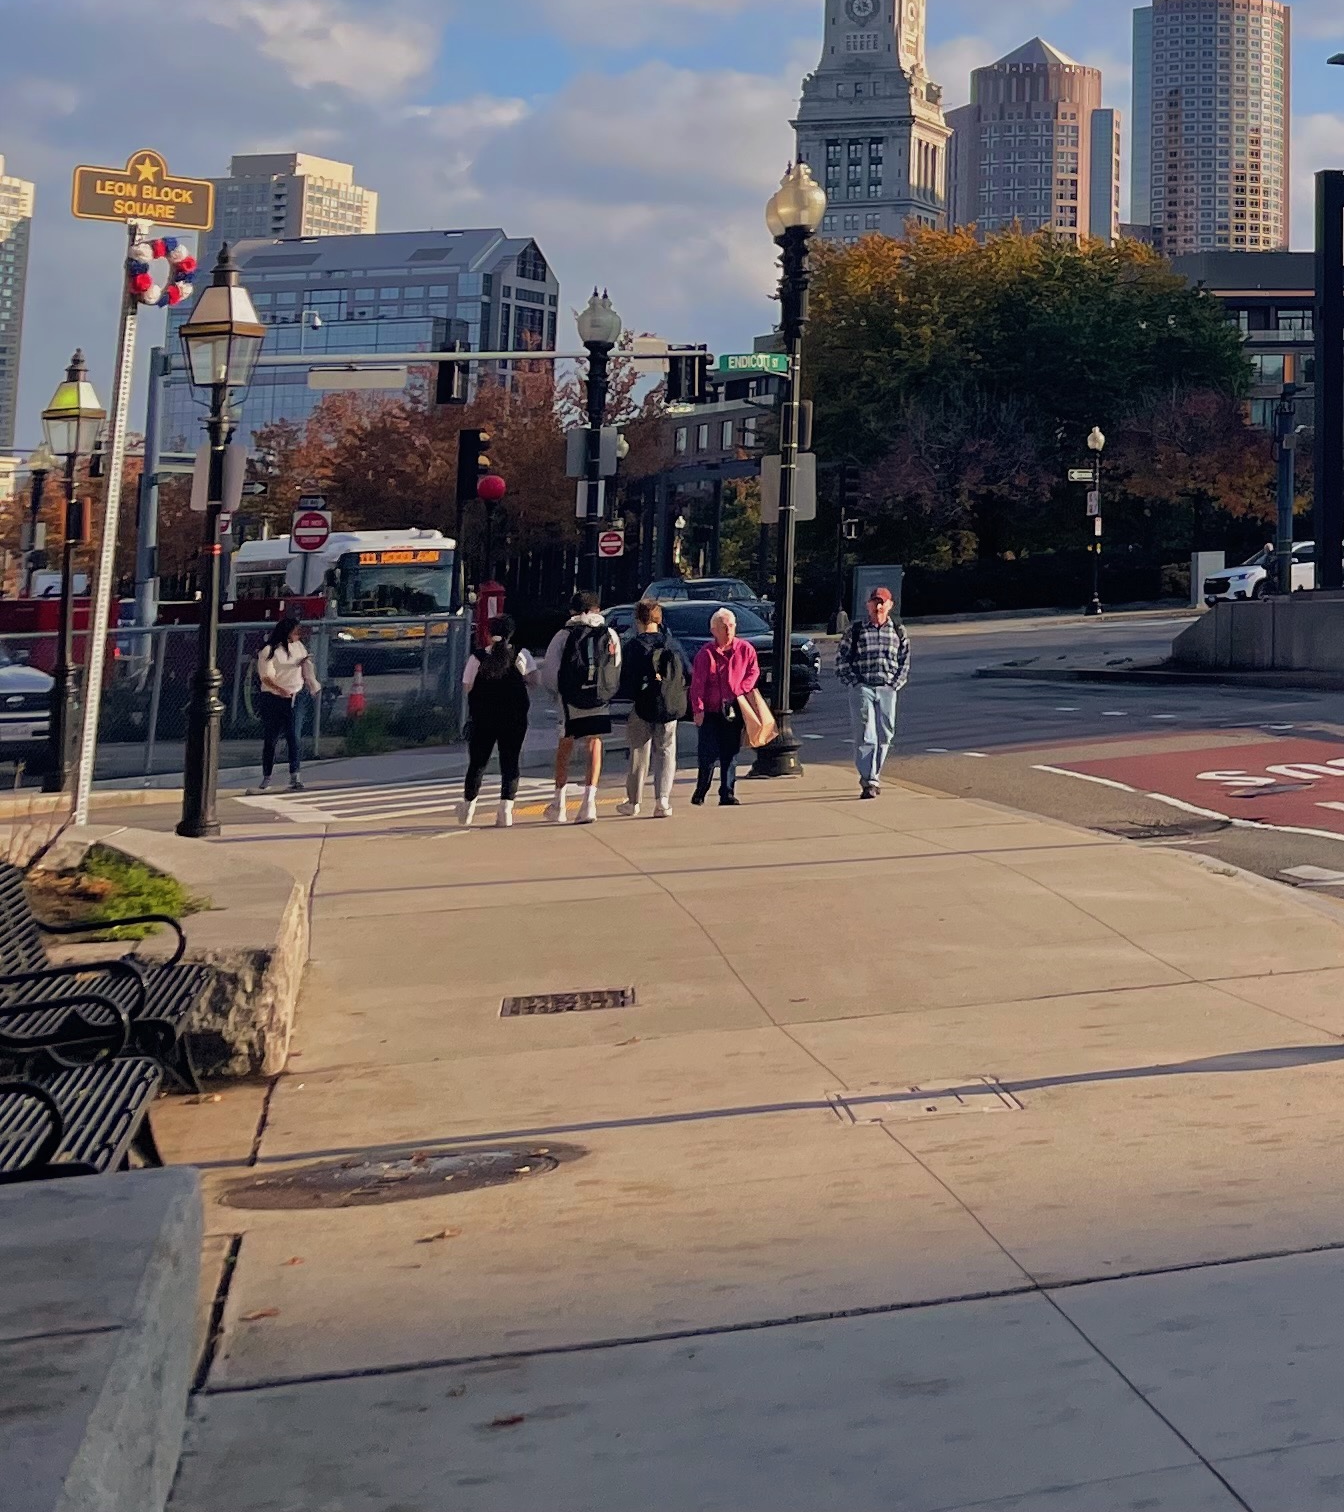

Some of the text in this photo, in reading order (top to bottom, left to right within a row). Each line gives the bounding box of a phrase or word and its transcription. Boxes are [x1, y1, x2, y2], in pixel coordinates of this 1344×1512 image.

[96, 180, 193, 204] LEON BLOCK
[113, 199, 176, 219] SQUARE
[728, 355, 770, 369] ENDICOTT
